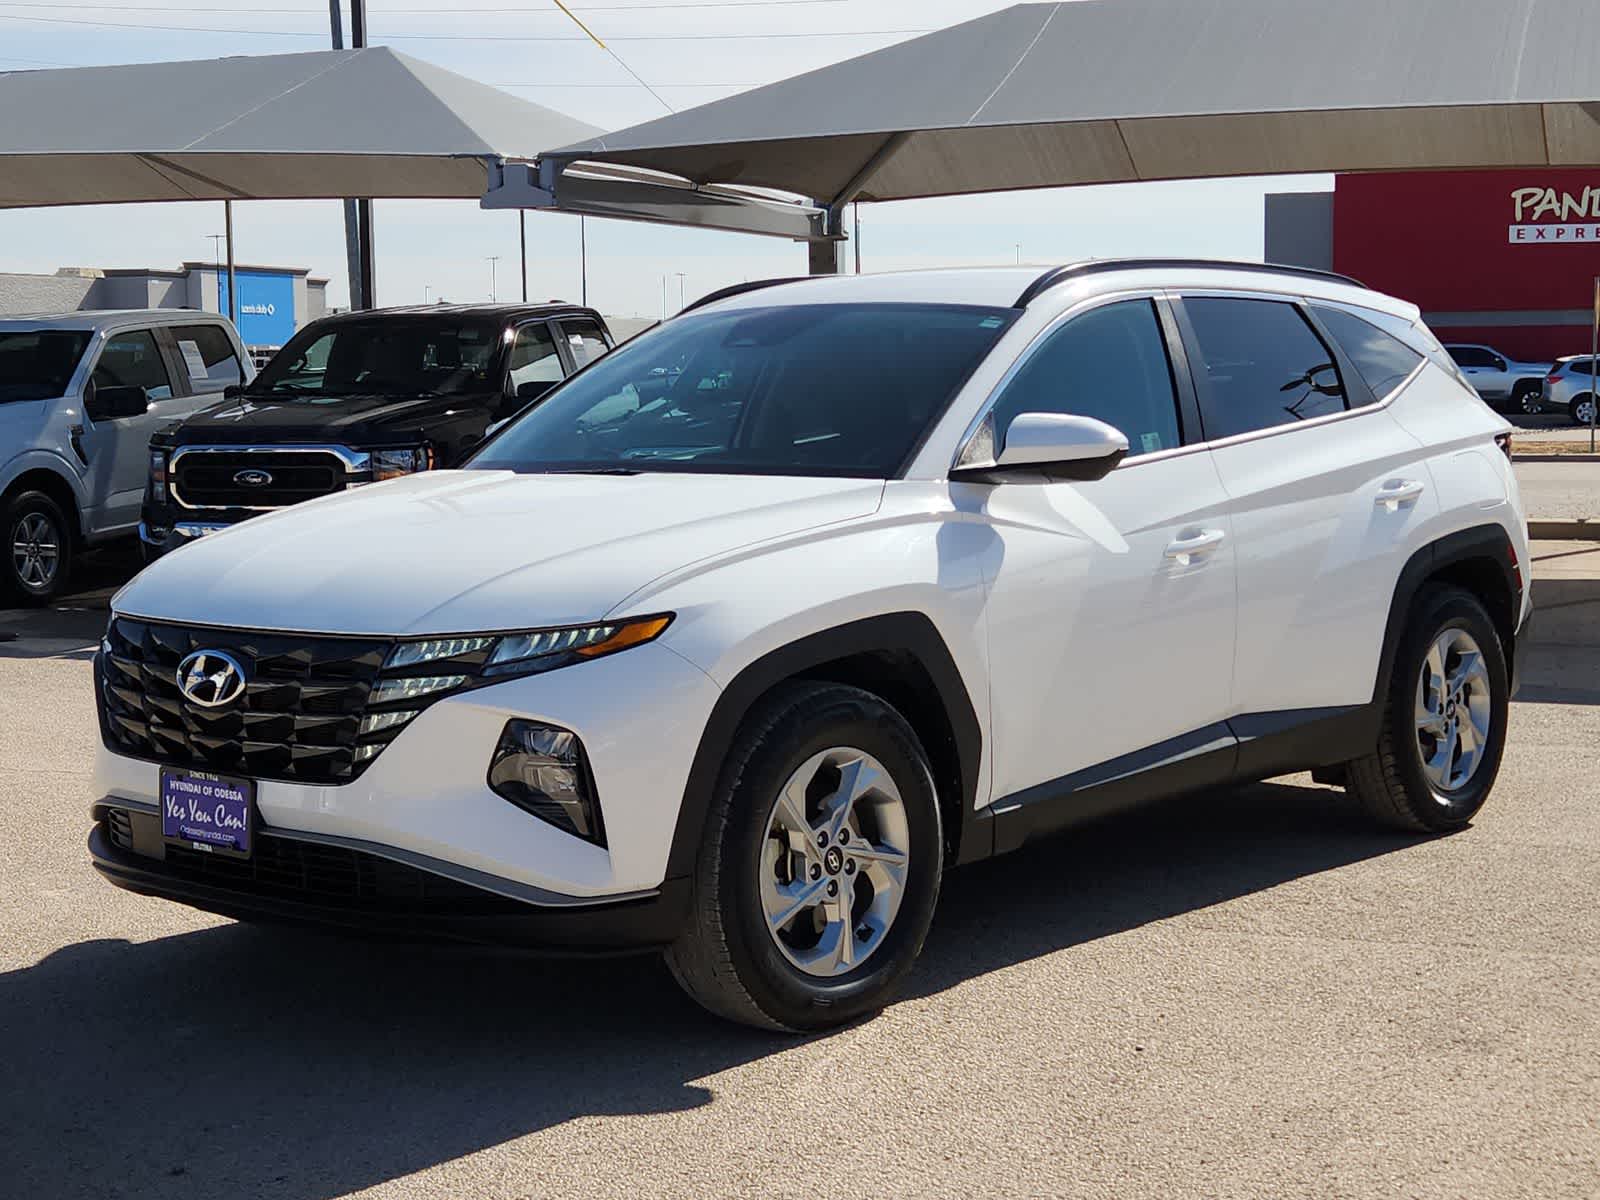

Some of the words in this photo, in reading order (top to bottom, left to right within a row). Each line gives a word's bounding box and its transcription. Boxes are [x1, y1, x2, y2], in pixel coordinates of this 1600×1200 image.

[169, 780, 201, 795] HYUNDAI
[202, 786, 213, 797] OF
[214, 788, 244, 801] ODESSA
[166, 795, 186, 820] Yes
[188, 799, 213, 823] You
[215, 804, 247, 831] Can!
